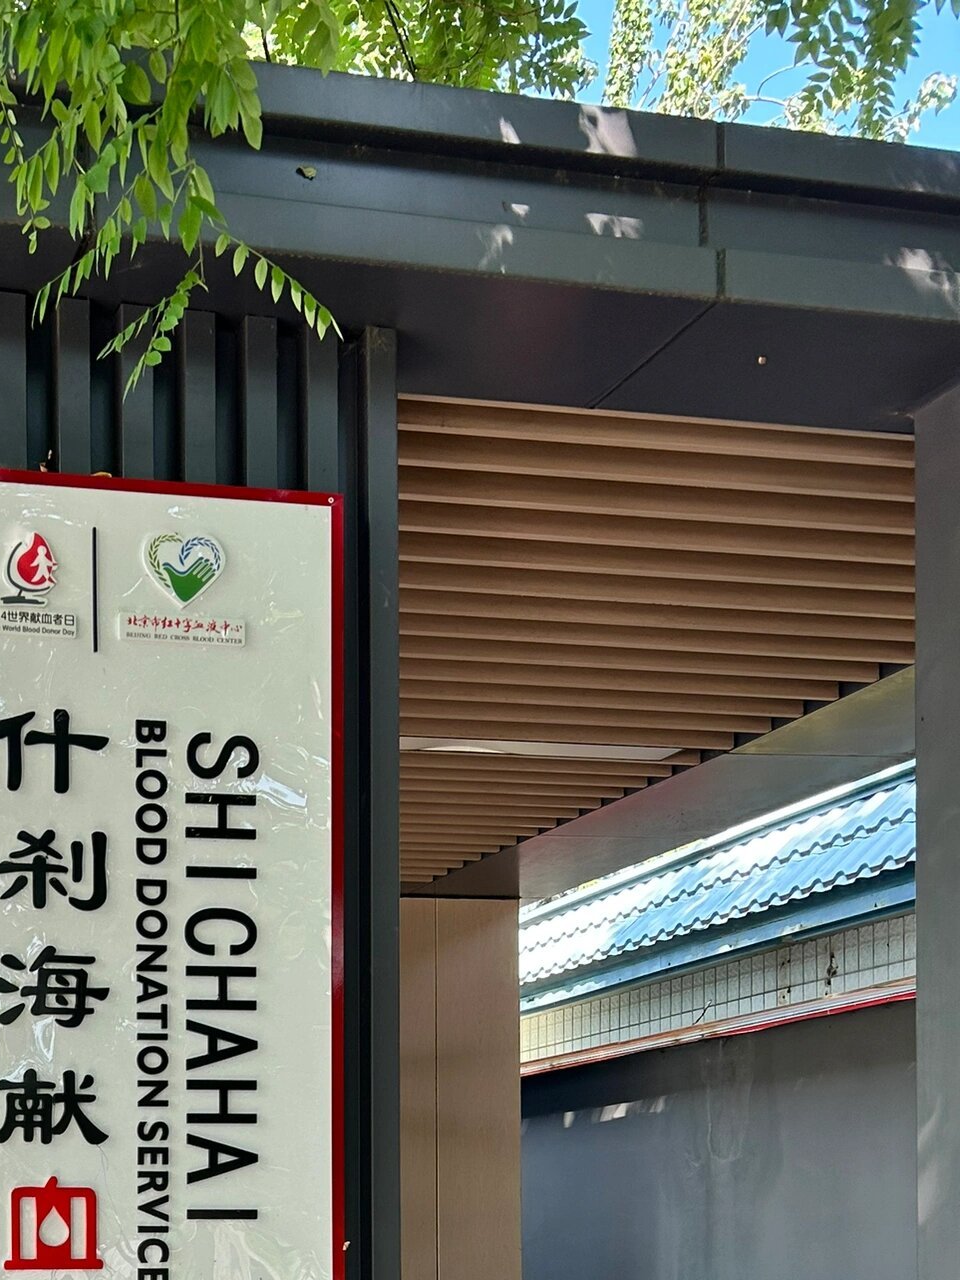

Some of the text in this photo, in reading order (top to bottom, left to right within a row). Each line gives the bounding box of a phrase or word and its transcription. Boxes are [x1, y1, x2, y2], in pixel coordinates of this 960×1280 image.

[62, 628, 75, 636] Day
[127, 615, 243, 636] 北京市红十字血液中心
[135, 719, 168, 866] BLOOD
[135, 878, 169, 1108] DONATION
[185, 732, 260, 1220] SHICHAHAI
